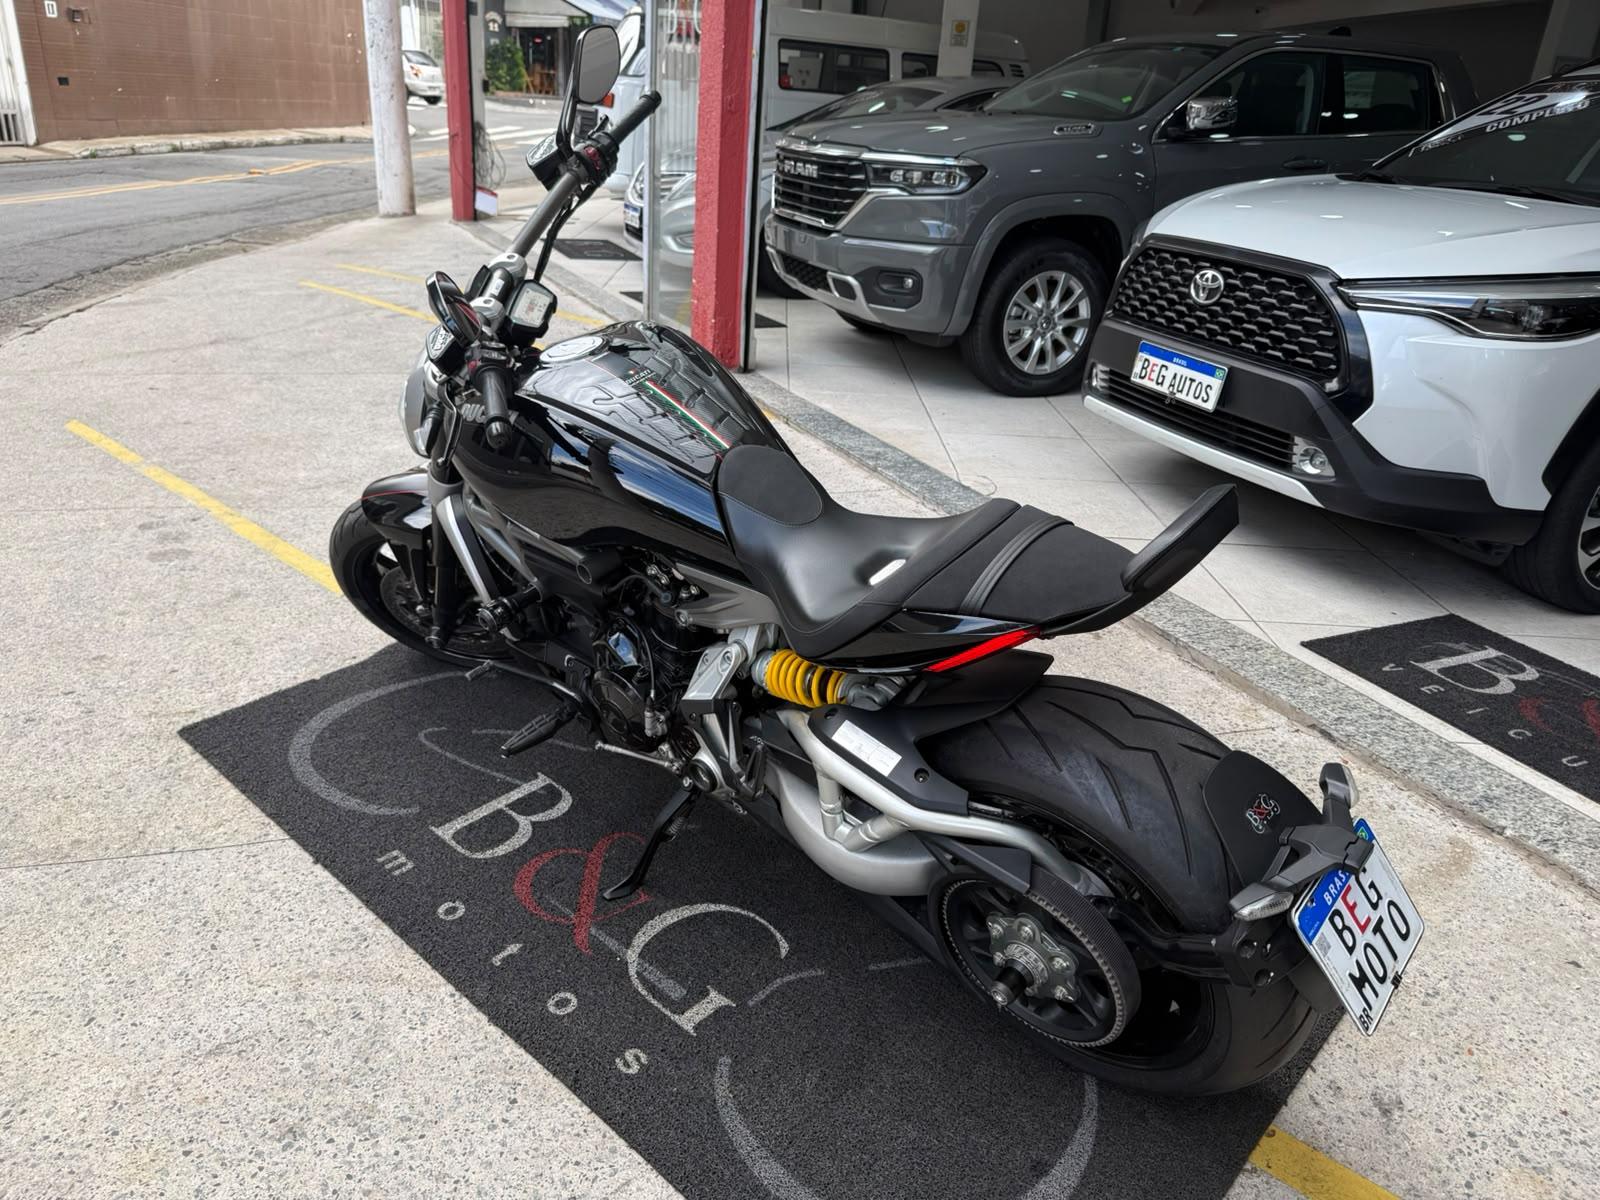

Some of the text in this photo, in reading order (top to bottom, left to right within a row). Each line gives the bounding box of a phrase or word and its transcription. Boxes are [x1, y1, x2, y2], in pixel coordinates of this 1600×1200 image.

[783, 160, 819, 178] RAM
[625, 369, 652, 386] DUCATI
[1139, 357, 1213, 403] BEG AUTOS
[461, 403, 487, 424] DUC
[1323, 869, 1350, 906] BRAS
[1328, 867, 1384, 957] BEG
[1348, 899, 1412, 1012] MOTO
[1358, 1007, 1375, 1033] BR
